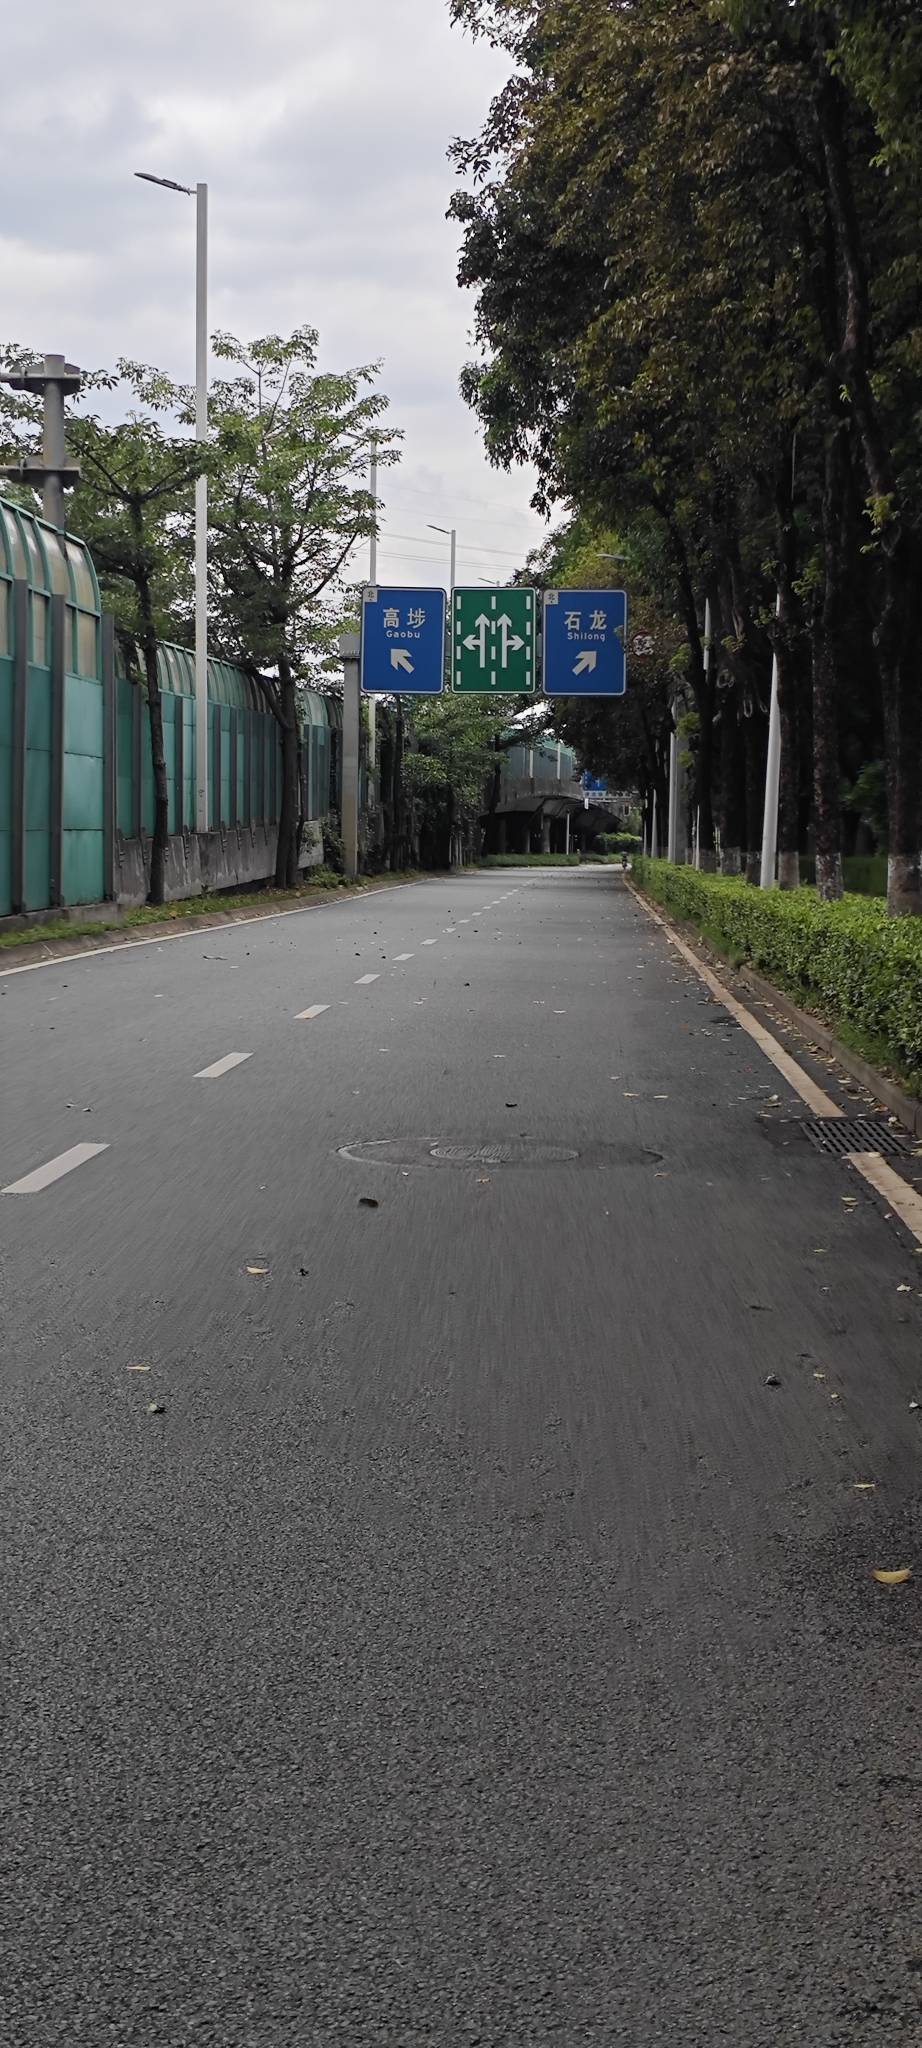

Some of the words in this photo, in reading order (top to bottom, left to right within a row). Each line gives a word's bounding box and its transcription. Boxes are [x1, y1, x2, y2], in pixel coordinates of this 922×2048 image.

[382, 607, 426, 629] 高埗
[563, 609, 607, 631] 石龙
[386, 630, 421, 639] Gaobu
[567, 632, 606, 642] Shilong
